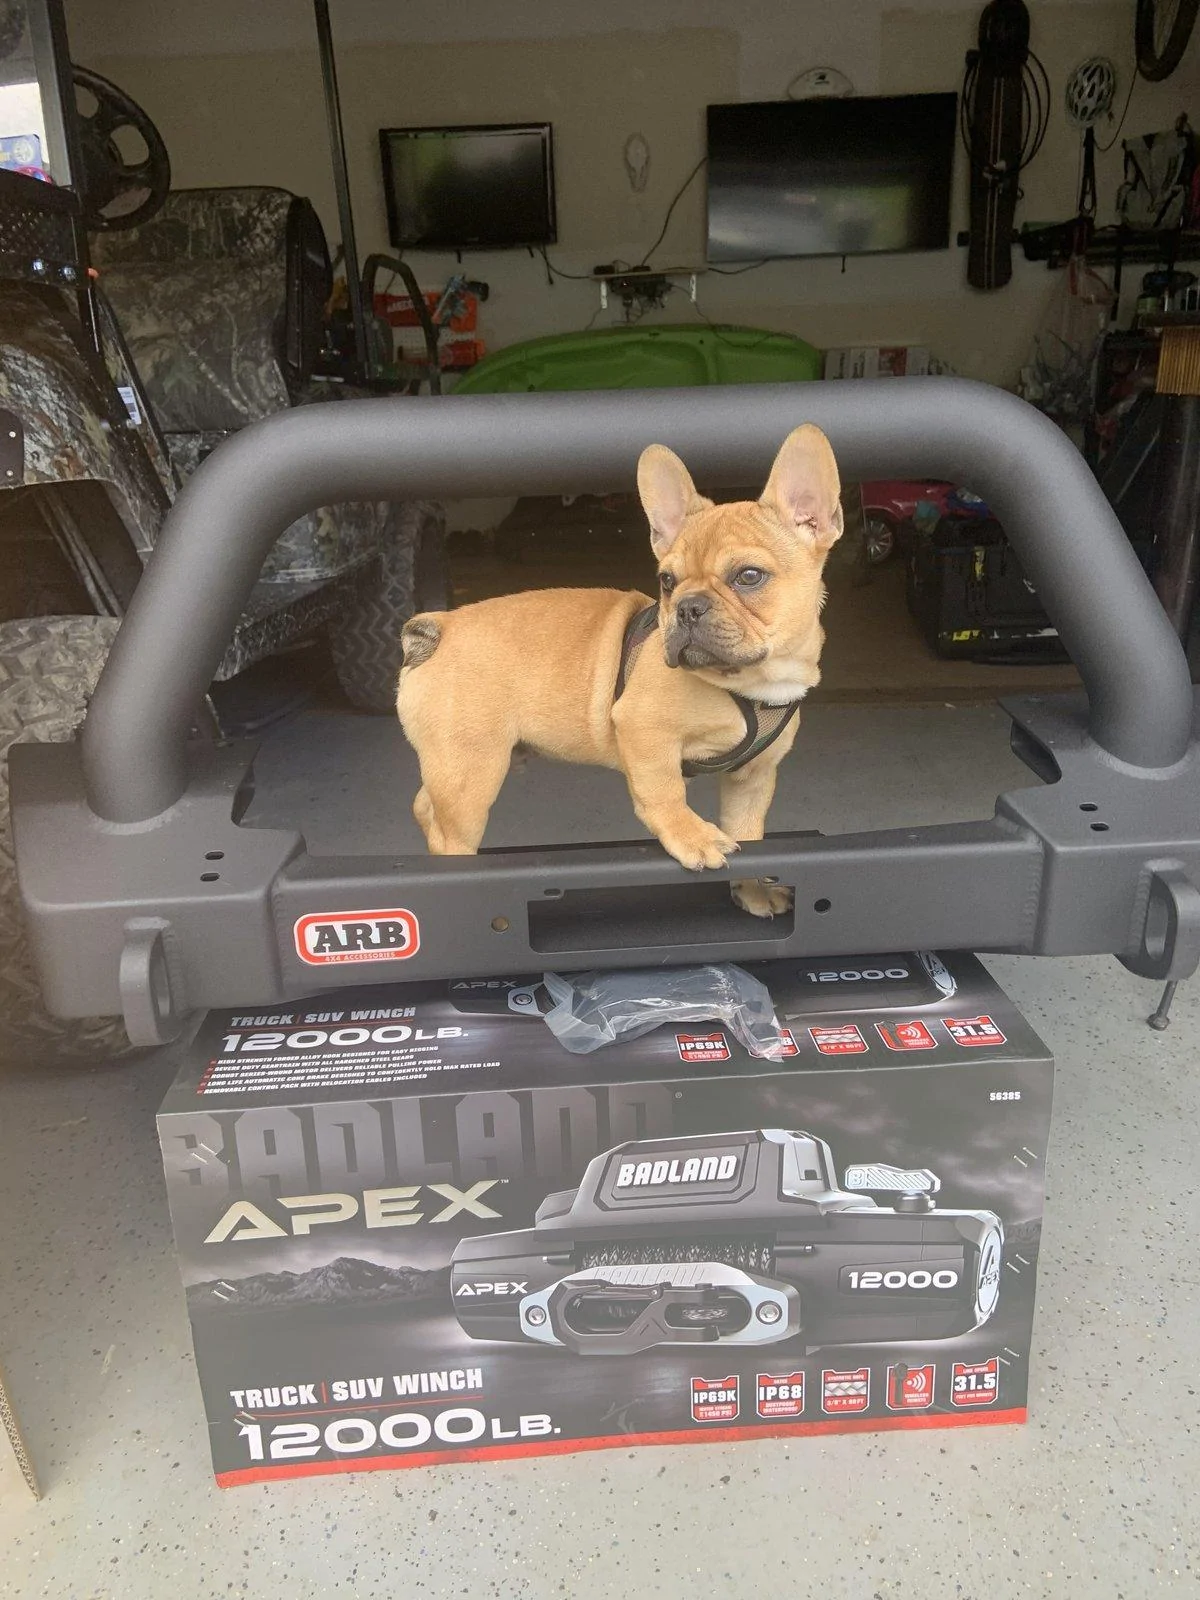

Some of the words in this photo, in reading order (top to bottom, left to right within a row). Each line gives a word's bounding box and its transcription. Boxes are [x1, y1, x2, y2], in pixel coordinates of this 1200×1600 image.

[313, 921, 406, 953] ARB
[344, 952, 396, 961] ACCESSORIES
[806, 968, 909, 983] 12000
[452, 980, 518, 990] APEX
[231, 1014, 294, 1027] TRUCK
[304, 1010, 344, 1024] SUV
[350, 1006, 416, 1021] WINCH
[950, 1024, 998, 1037] 31.5
[989, 1091, 1021, 1101] 56385
[616, 1155, 738, 1187] BADLAND
[202, 1179, 503, 1245] APEX
[848, 1270, 958, 1289] 12000
[455, 1281, 529, 1297] APEX
[230, 1383, 318, 1409] TRUCK
[331, 1377, 384, 1401] SUV
[393, 1368, 483, 1394] WINCH
[954, 1373, 996, 1391] 31.5
[694, 1389, 737, 1404] IP69K
[759, 1384, 802, 1400] IP68
